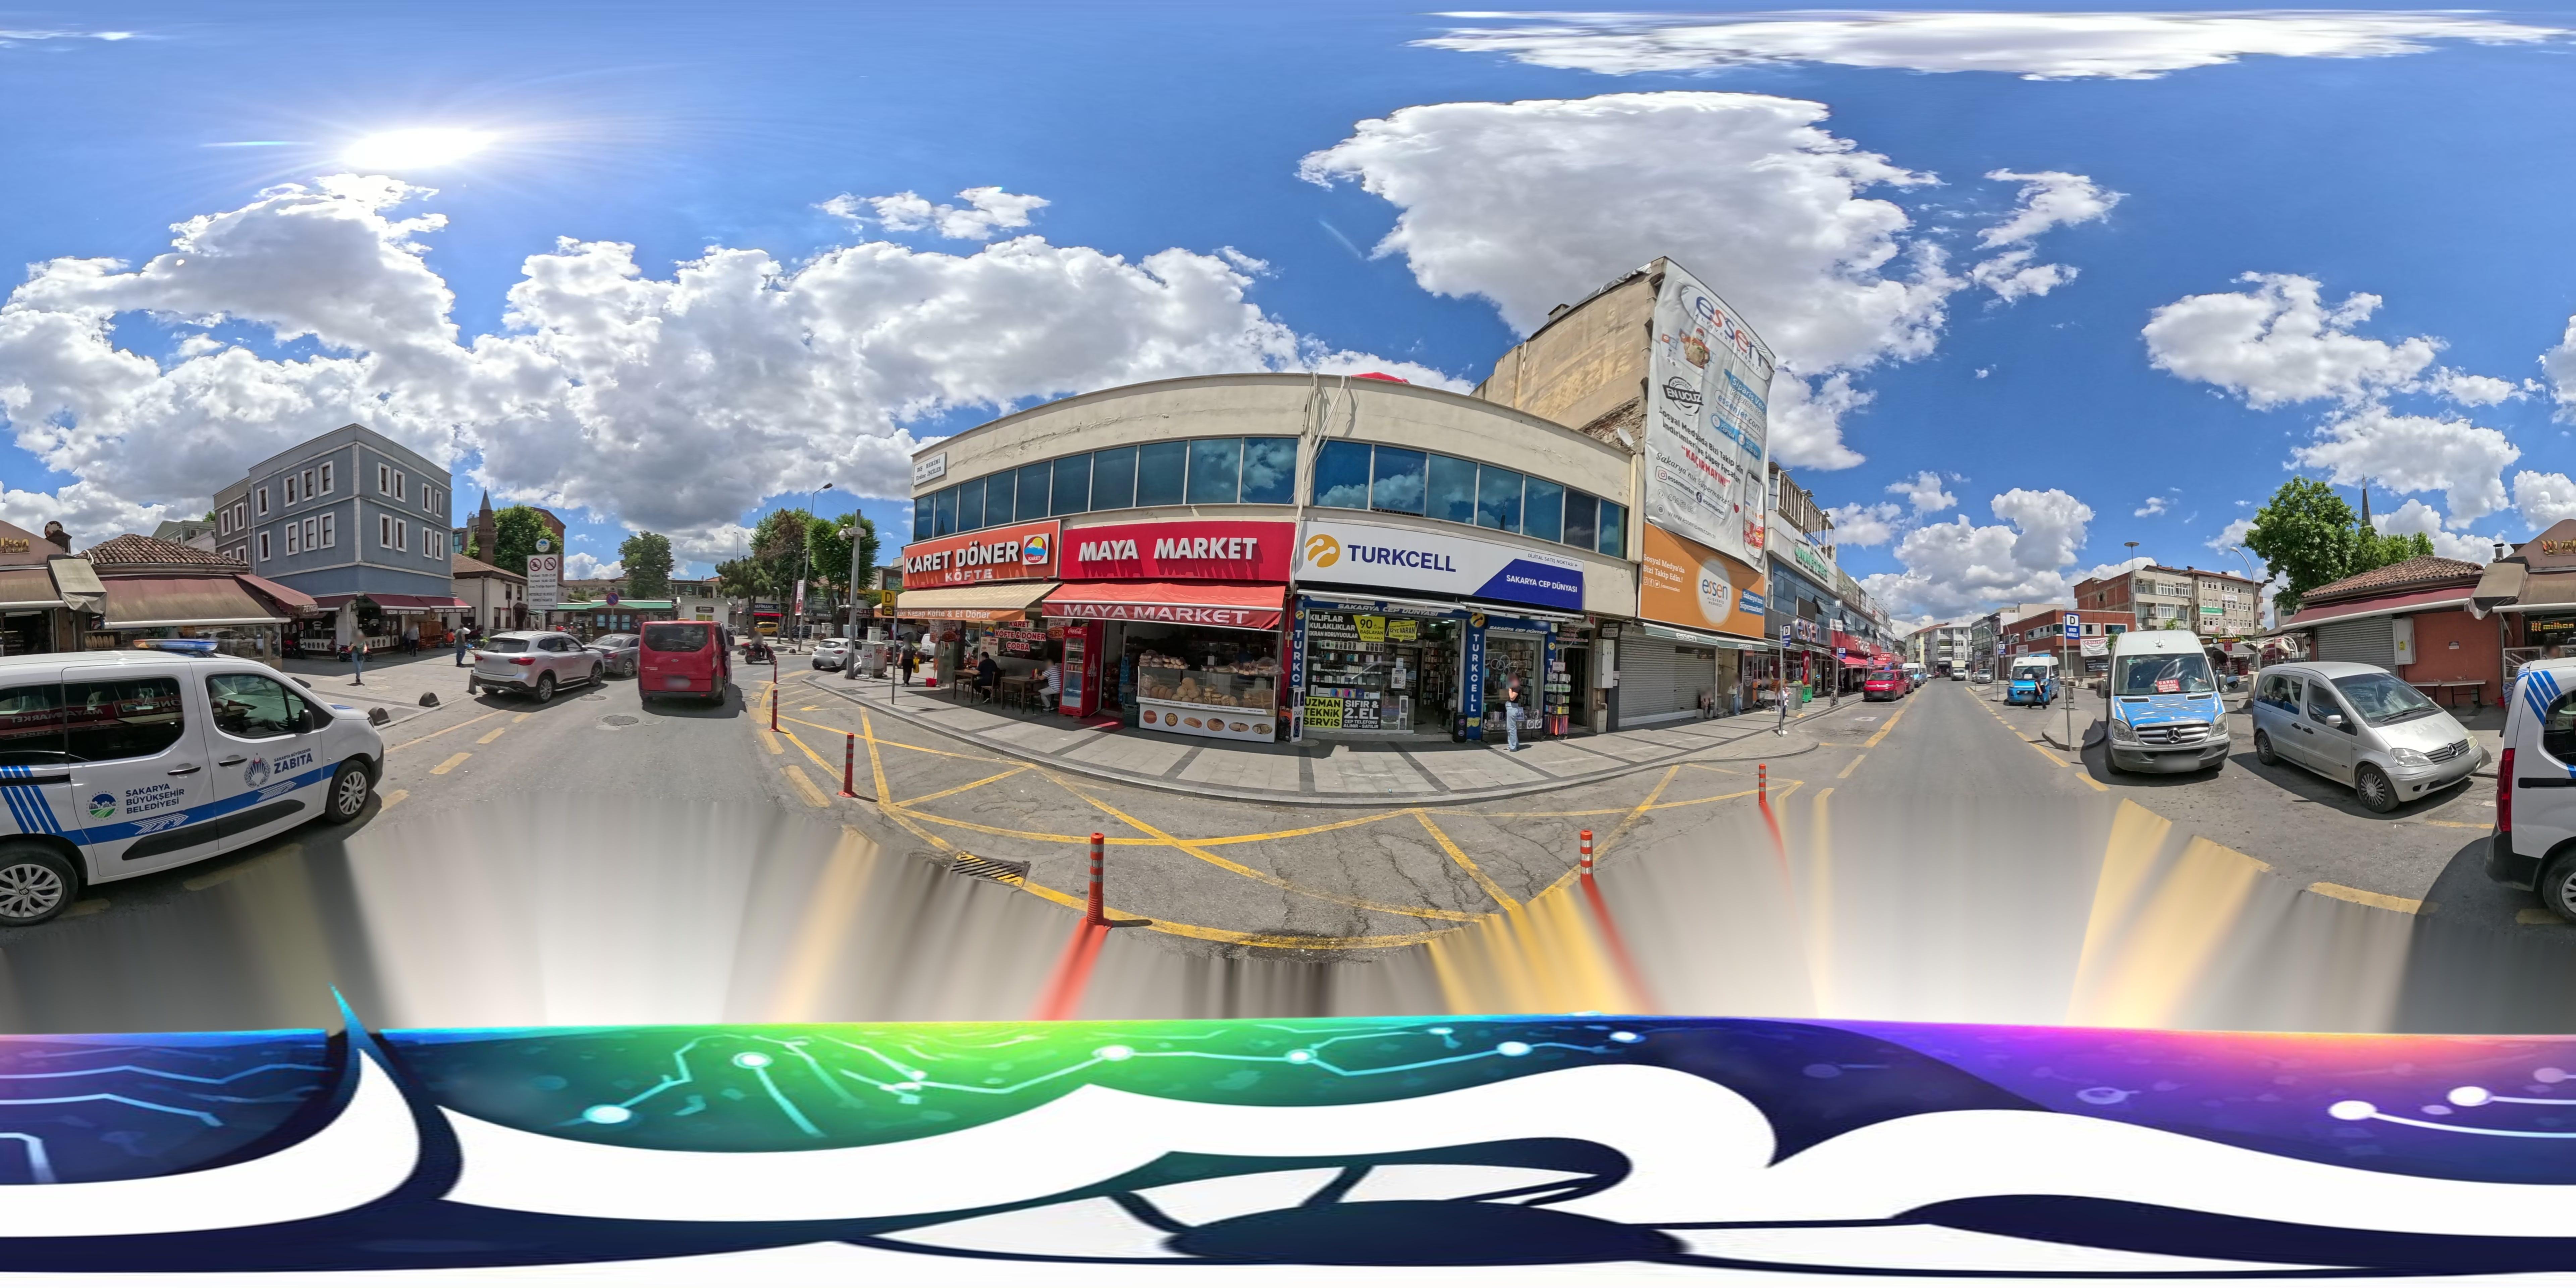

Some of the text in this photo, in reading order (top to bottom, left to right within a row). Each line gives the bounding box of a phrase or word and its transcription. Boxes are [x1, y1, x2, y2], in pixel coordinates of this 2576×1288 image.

[1696, 296, 1761, 367] essen
[1666, 387, 1702, 402] EN UCUZ
[1732, 378, 1754, 402] Sipariş
[1718, 394, 1762, 433] essenjet.com
[1682, 422, 1708, 447] Medyada
[1709, 442, 1719, 456] Bizi
[1720, 450, 1734, 466] Takip
[1705, 451, 1720, 469] Süper
[1656, 452, 1732, 506] Sakarya'nın Süpermarketi
[1668, 475, 1724, 516] essenmarket essenmarket
[905, 540, 1020, 574] KARET DÖNER
[1078, 537, 1257, 561] MAYA MARKET
[1347, 544, 1456, 572] TURKCELL
[1643, 553, 1685, 574] Sosyal Medya'da
[1643, 565, 1654, 574] Bizi
[1655, 568, 1669, 580] Takip
[945, 568, 993, 582] KÖFTE
[1506, 575, 1577, 593] SAKARYA CEP DÜNYASI
[885, 592, 892, 603] D
[1702, 579, 1728, 600] essen
[908, 609, 925, 618] Kasap
[927, 609, 945, 617] Köfte
[955, 610, 963, 618] Et
[966, 609, 990, 618] Döner
[1063, 604, 1249, 624] MAYA MARKET
[1337, 603, 1380, 612] SAKARYA
[1402, 608, 1439, 616] DÜNYASI
[1309, 622, 1356, 631] KULAKLIKLAR
[1310, 614, 1373, 629] KILIFLAR 90
[2070, 616, 2076, 625] D
[995, 628, 1015, 638] KÖFTE
[1022, 630, 1046, 641] DÖNER
[1676, 632, 1697, 642] essen
[1785, 627, 1789, 635] D
[1796, 618, 1821, 644] essen
[1007, 642, 1030, 652] ÇORBA
[1292, 629, 1302, 683] TURKC
[1470, 634, 1480, 712] TURKCELL
[1305, 698, 1341, 708] UZMAN
[1345, 700, 1370, 708] SIFIR
[1344, 707, 1379, 720] 2.EL
[274, 754, 291, 762] SAKARYA
[274, 753, 313, 774] ZABITA
[126, 783, 170, 797] SAKARYA
[126, 788, 185, 806] BÜYÜKŞEHİR
[126, 797, 179, 814] BELEDİYESİ
